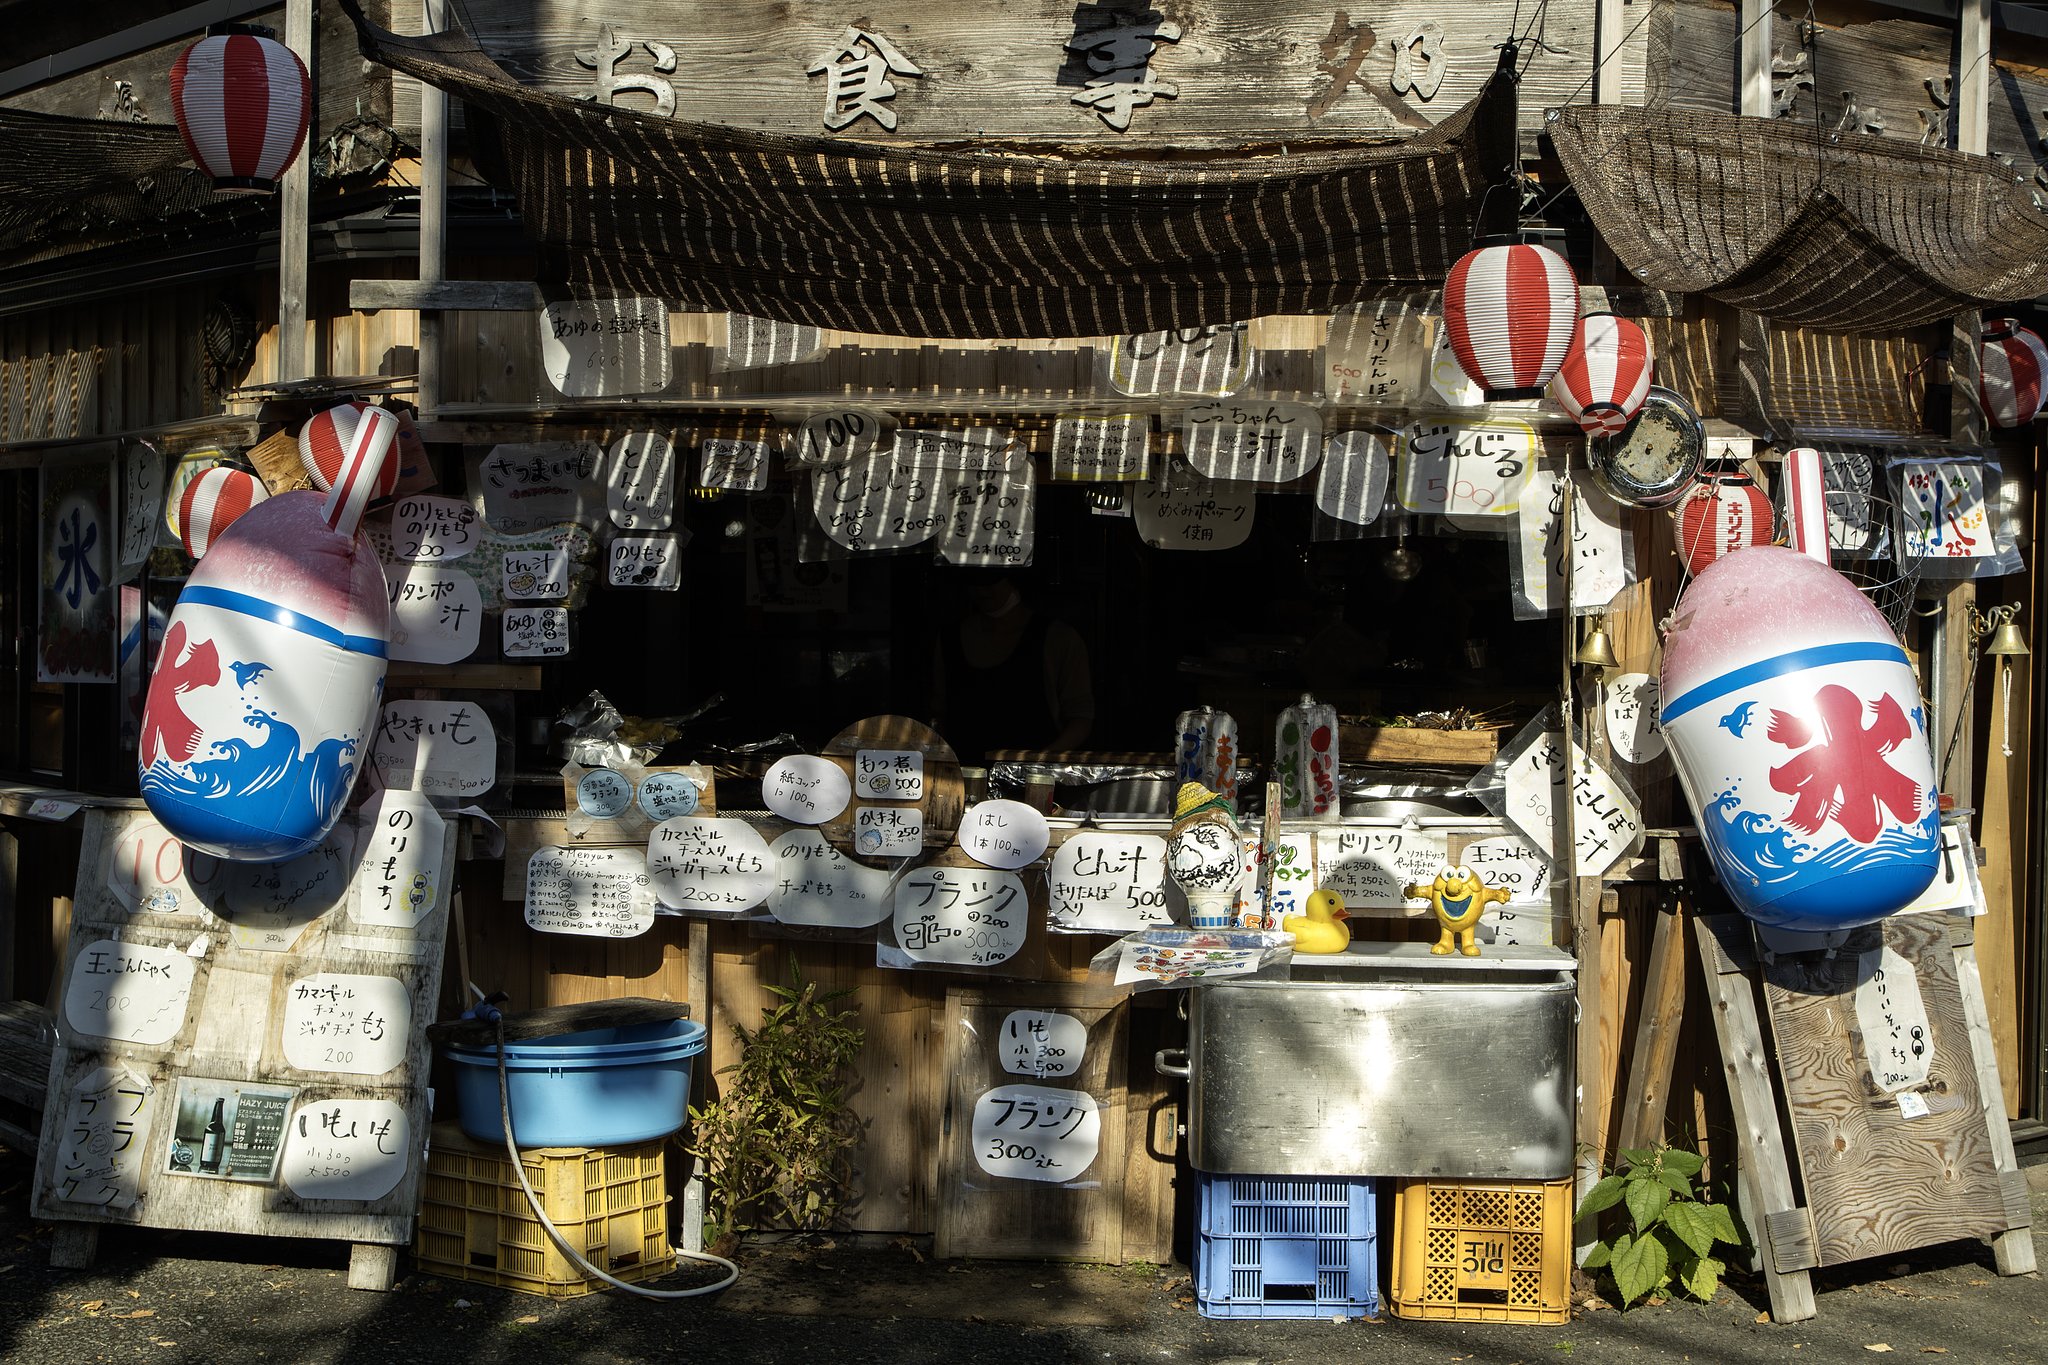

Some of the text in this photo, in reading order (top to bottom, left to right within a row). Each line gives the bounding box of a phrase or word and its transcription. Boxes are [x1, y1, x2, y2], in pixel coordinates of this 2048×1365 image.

[552, 314, 665, 339] あゆの塩焼き
[586, 351, 619, 369] 600
[1369, 313, 1399, 395] きりたんぽ
[1331, 364, 1363, 379] 500
[1190, 402, 1296, 426] ごっちゃん
[806, 412, 865, 459] 100
[1246, 429, 1283, 465] 汁
[1409, 424, 1524, 478] どんじる
[488, 451, 594, 488] さつまいも
[620, 448, 645, 528] とんじる
[1426, 477, 1495, 508] 500
[982, 516, 1011, 531] 600
[1182, 524, 1213, 541] 使用
[406, 522, 469, 545] のりもち
[404, 541, 445, 557] 200
[615, 545, 667, 564] のりもち
[994, 544, 1021, 555] 1000
[54, 507, 99, 611] 氷
[506, 553, 556, 575] とん汁
[613, 564, 635, 576] 200
[537, 581, 561, 596] 500
[440, 603, 471, 632] 汁
[506, 614, 536, 632] あゆ
[1615, 683, 1639, 720] そば
[378, 707, 477, 745] やきいも
[859, 754, 914, 775] もつ煮
[1767, 684, 1922, 845] 氷
[779, 770, 821, 787] 紙コップ
[895, 777, 921, 791] 500
[645, 783, 673, 795] あゆの
[789, 788, 816, 811] 100円
[859, 809, 906, 828] かき氷
[1526, 793, 1558, 828] 500
[977, 813, 1009, 828] はし
[659, 826, 723, 842] カマンベール
[896, 826, 920, 838] 250
[679, 843, 727, 860] チーズ入り
[780, 843, 842, 860] のりもち
[993, 836, 1022, 857] 100円
[1338, 833, 1403, 855] ドリンク
[1576, 828, 1609, 863] 汁
[377, 809, 414, 911] のりもち
[1072, 845, 1148, 883] とん汁
[1394, 856, 1436, 869] ペットボトル
[1406, 849, 1446, 860] ソフトドリンク
[833, 863, 847, 871] 200
[1319, 860, 1352, 874] 缶ビール
[1321, 872, 1357, 887] ノンアル缶
[1484, 870, 1522, 886] 200
[682, 887, 747, 904] 200えん
[778, 878, 866, 899] チーズもち 200
[1053, 882, 1117, 901] きりたんぽ
[1126, 886, 1166, 910] 500
[1056, 900, 1085, 917] 入り
[89, 989, 131, 1013] 200
[294, 984, 355, 1003] カマンベール
[299, 1021, 356, 1037] ジャガチーズ
[324, 1047, 354, 1064] 200
[1038, 1045, 1066, 1057] 300
[1035, 1061, 1065, 1073] 500
[239, 1098, 287, 1110] HAZY JUICE
[989, 1098, 1087, 1141] フランク
[986, 1138, 1063, 1169] 300えん
[1462, 1257, 1504, 1274] DIC
